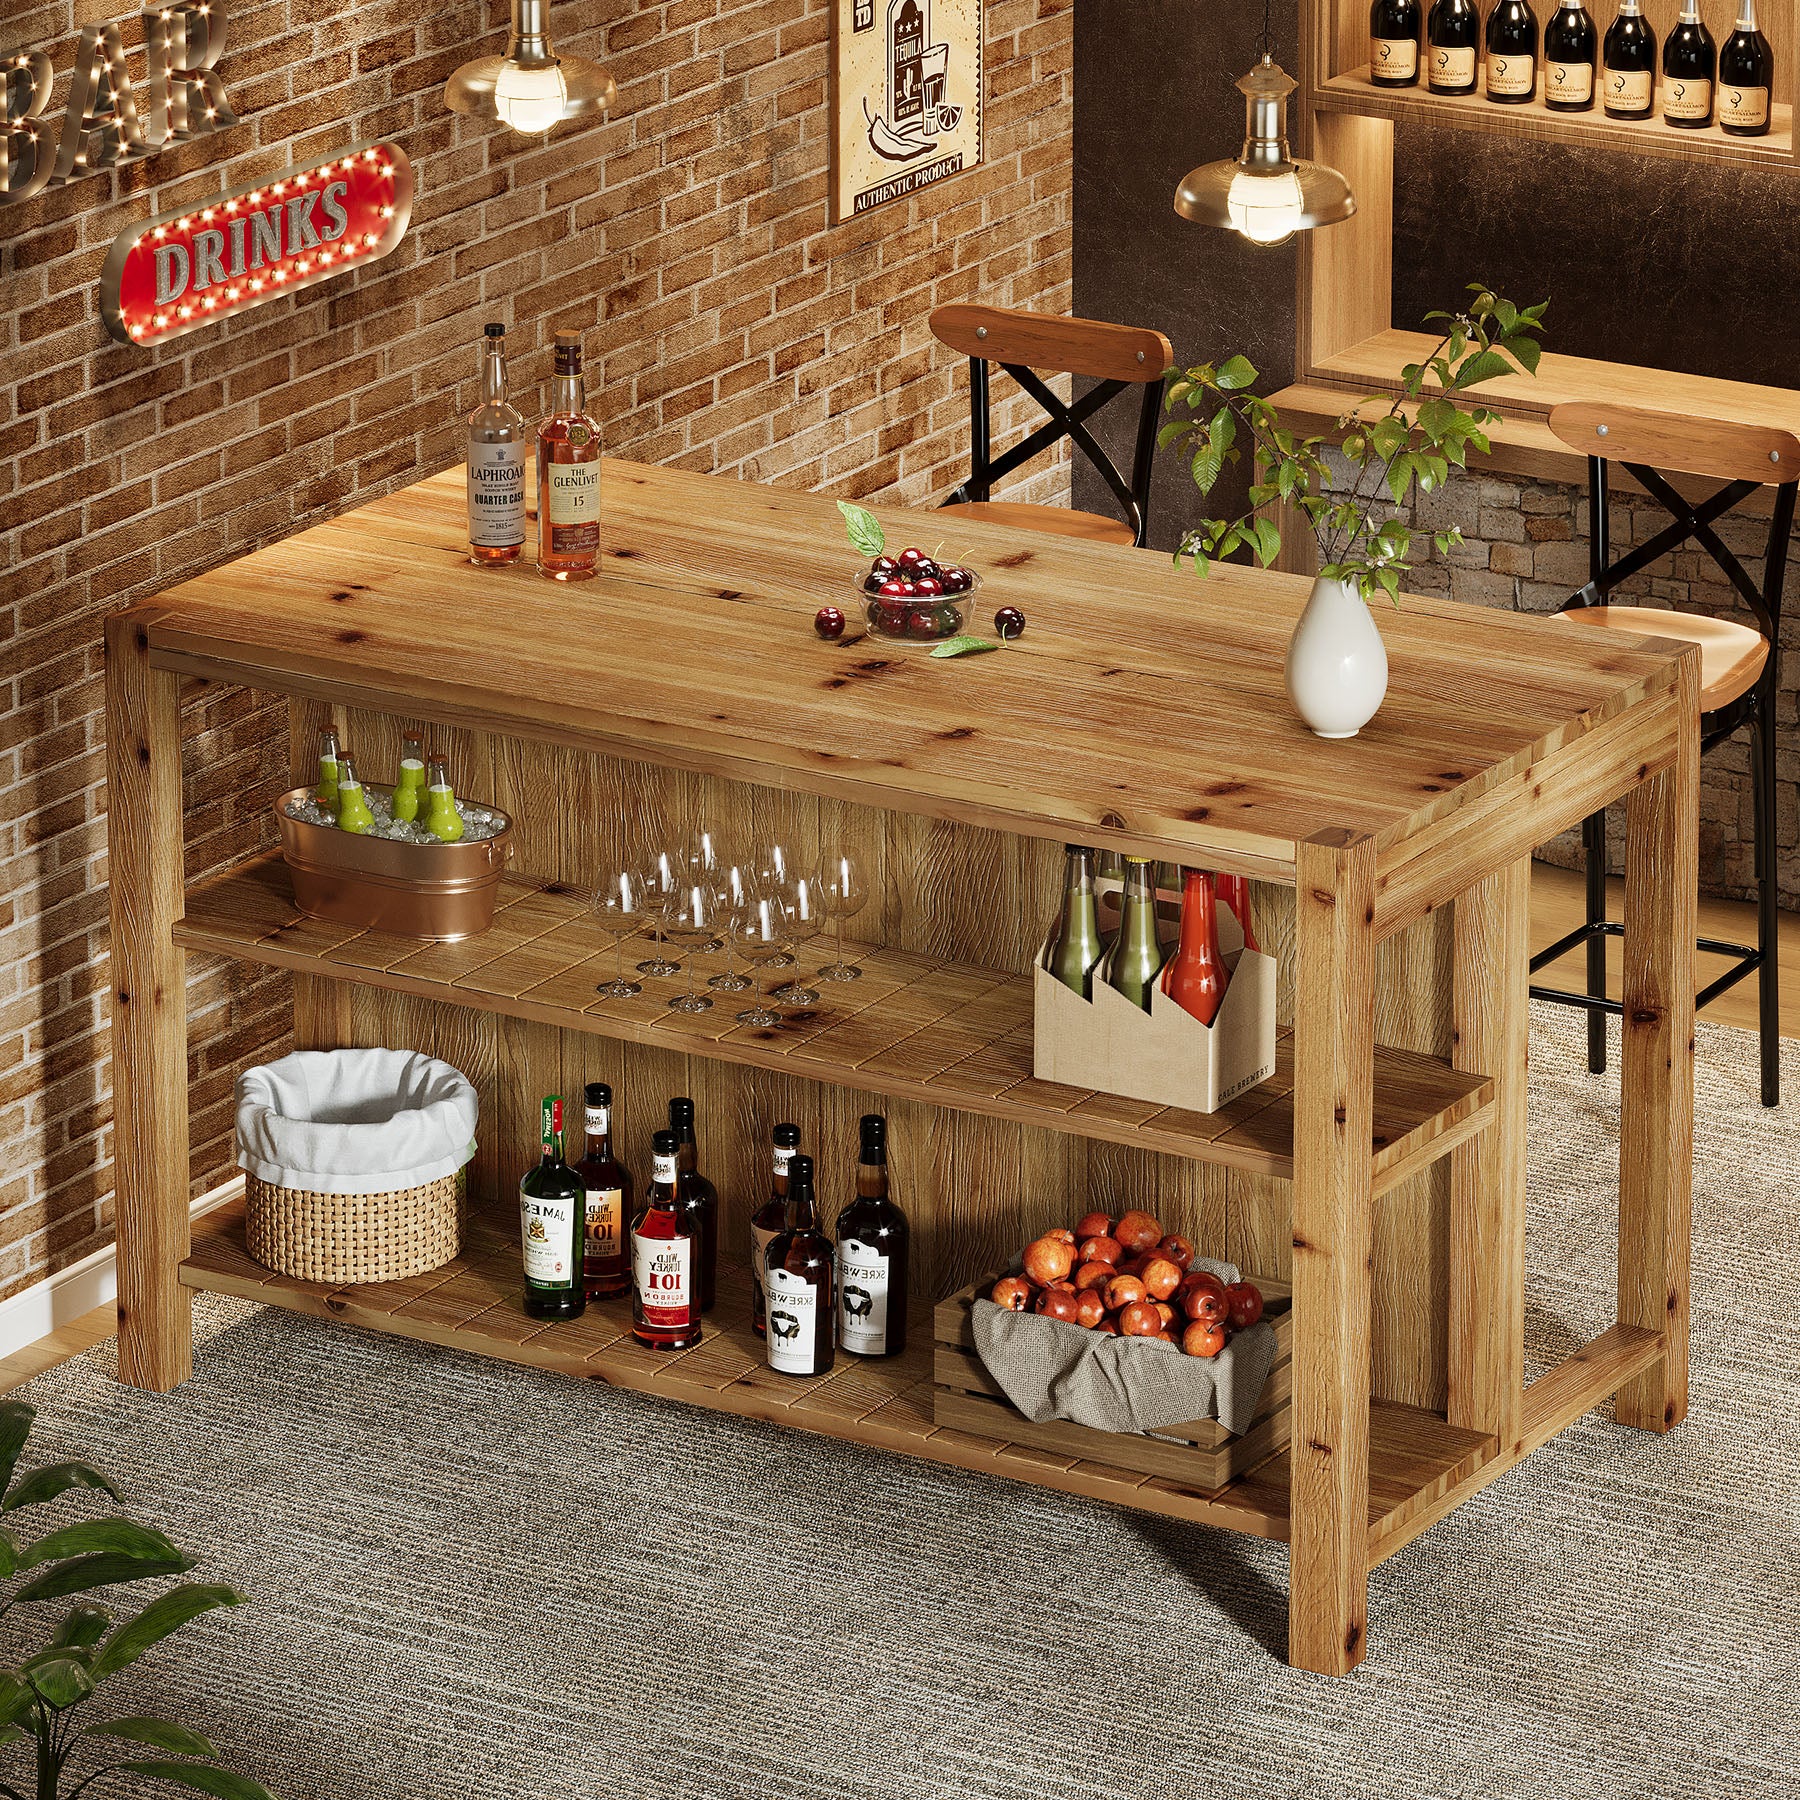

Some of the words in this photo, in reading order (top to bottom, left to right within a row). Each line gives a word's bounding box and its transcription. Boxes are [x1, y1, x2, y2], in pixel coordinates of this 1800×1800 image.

[895, 37, 923, 62] TEQUILA
[0, 0, 239, 208] BAR
[855, 175, 913, 212] AUTHENTIC
[914, 155, 962, 188] PRODUCT
[153, 181, 348, 306] DRINKS
[553, 473, 598, 487] GLENLIVET
[571, 468, 586, 477] THE
[474, 493, 508, 505] QUARTER
[573, 495, 584, 507] 15
[1237, 1065, 1268, 1091] BREWERY
